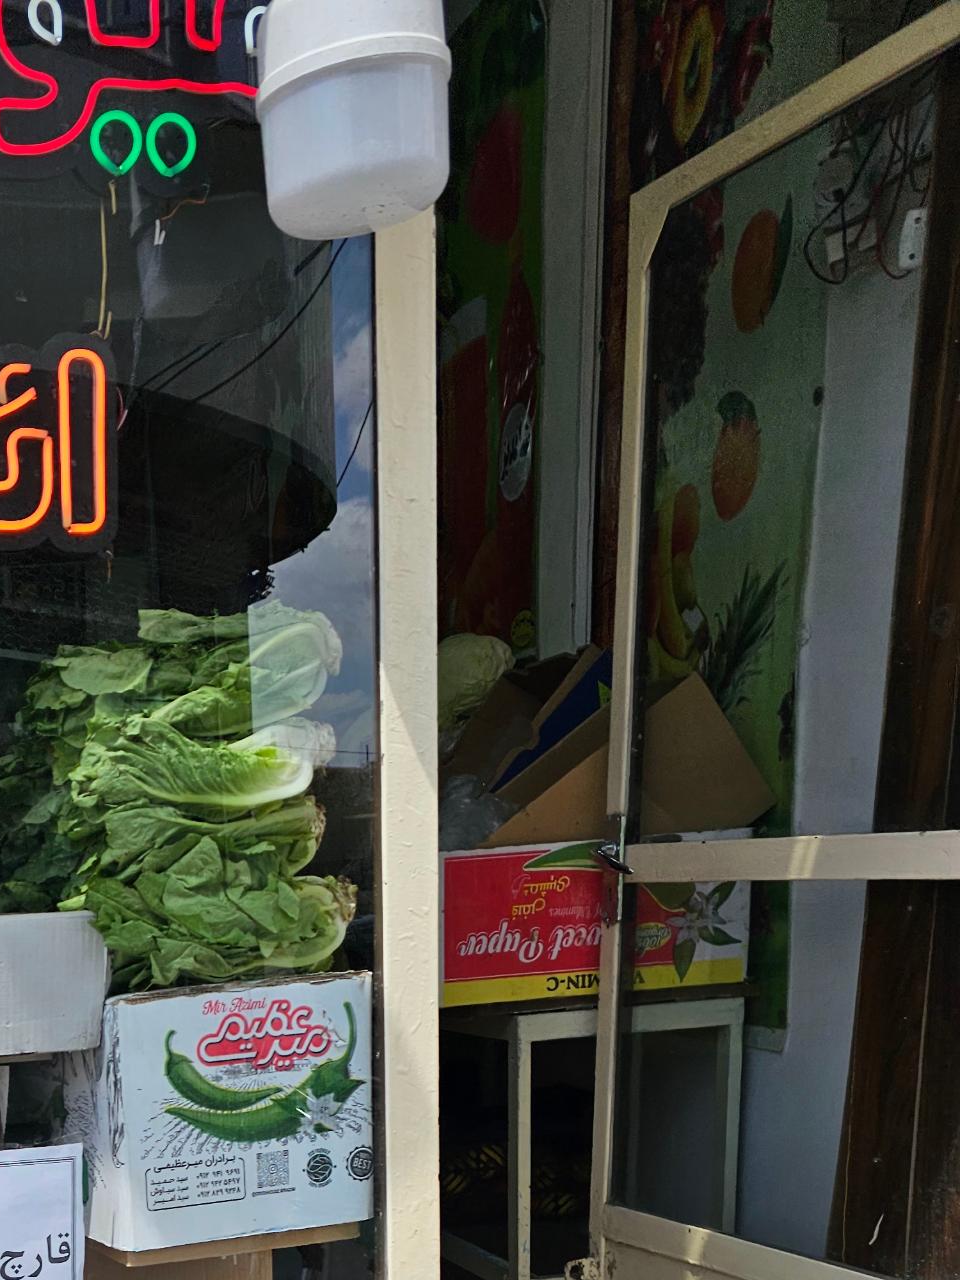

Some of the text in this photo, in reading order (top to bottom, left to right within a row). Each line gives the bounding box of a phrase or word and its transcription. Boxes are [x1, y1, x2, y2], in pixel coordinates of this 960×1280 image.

[202, 1000, 226, 1016] Mir
[205, 1154, 236, 1167] برادران
[352, 1158, 373, 1170] BEST
